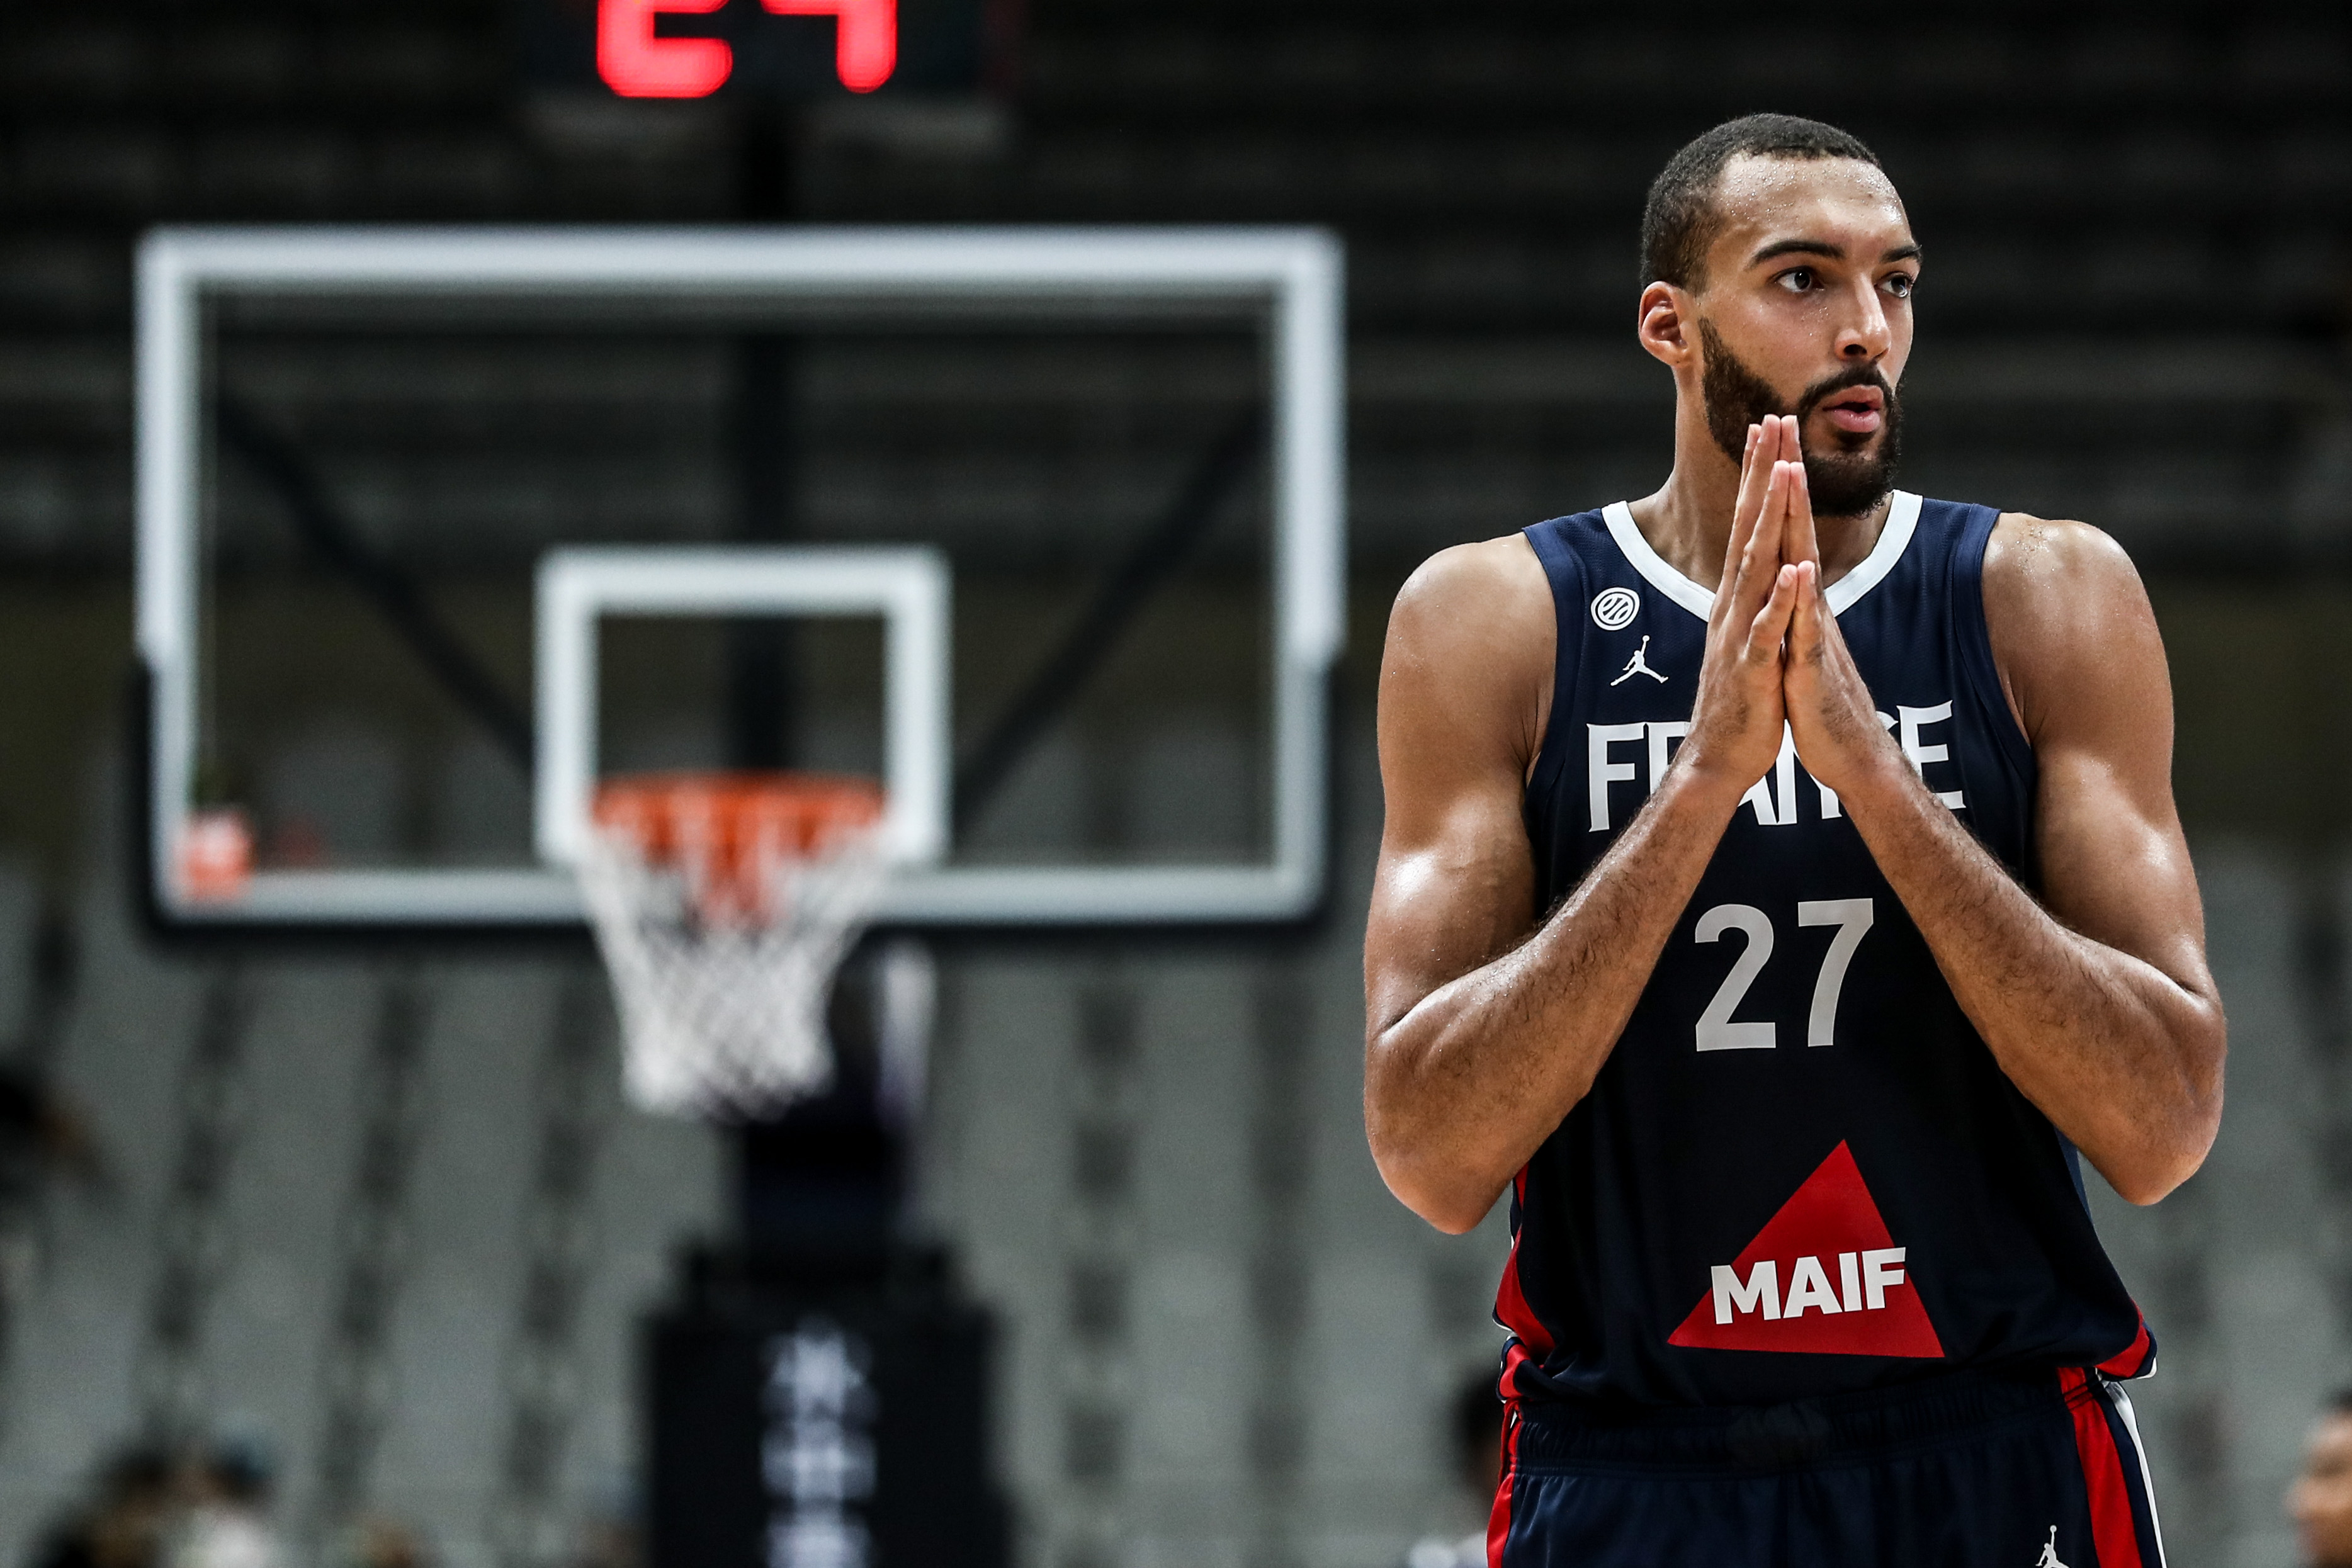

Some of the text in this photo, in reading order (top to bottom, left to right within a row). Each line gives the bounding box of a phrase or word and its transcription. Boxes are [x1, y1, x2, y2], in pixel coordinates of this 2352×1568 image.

[1586, 700, 1966, 832] FNE
[1695, 898, 1874, 1051] 27
[1710, 1247, 1906, 1324] MAIF
